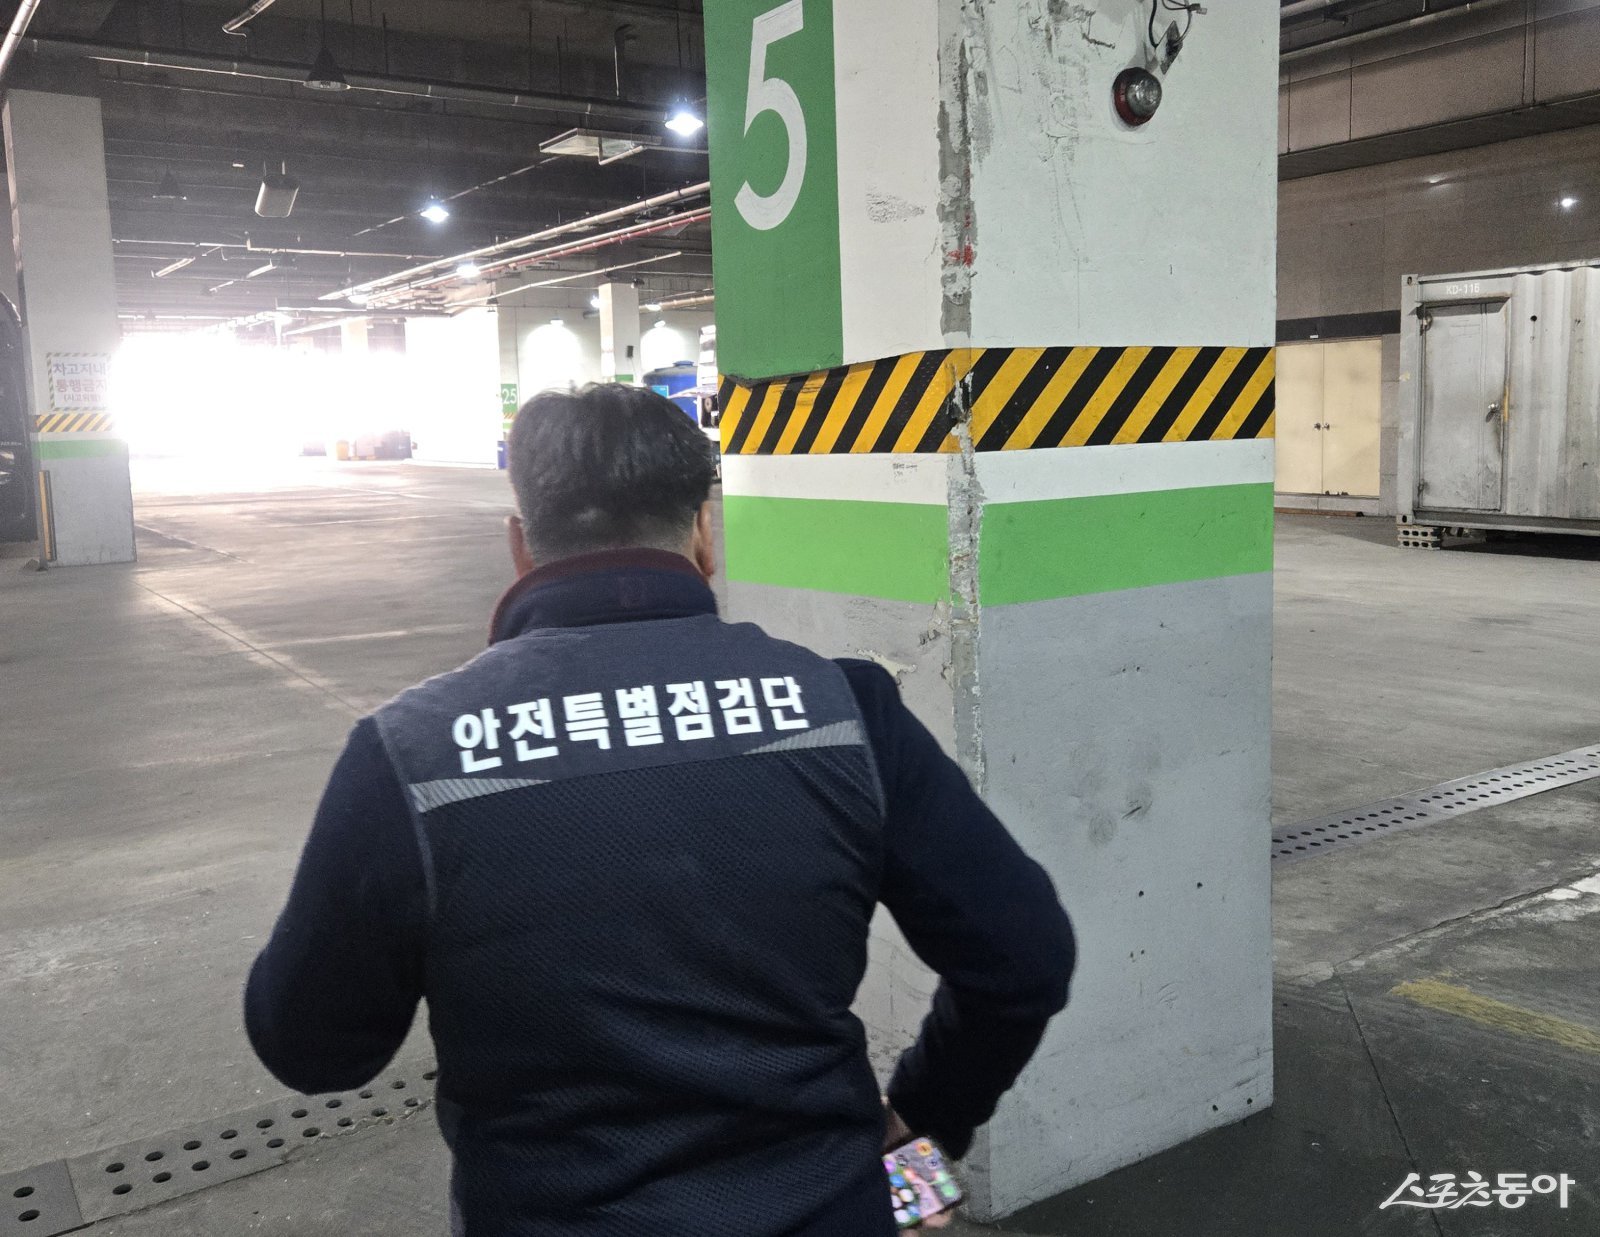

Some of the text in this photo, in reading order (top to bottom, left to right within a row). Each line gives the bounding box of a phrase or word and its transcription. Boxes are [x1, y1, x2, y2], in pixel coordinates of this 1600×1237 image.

[734, 0, 807, 231] 5
[56, 379, 107, 392] 통행금지
[502, 388, 517, 404] 25
[452, 676, 809, 773] 안전특별점검단
